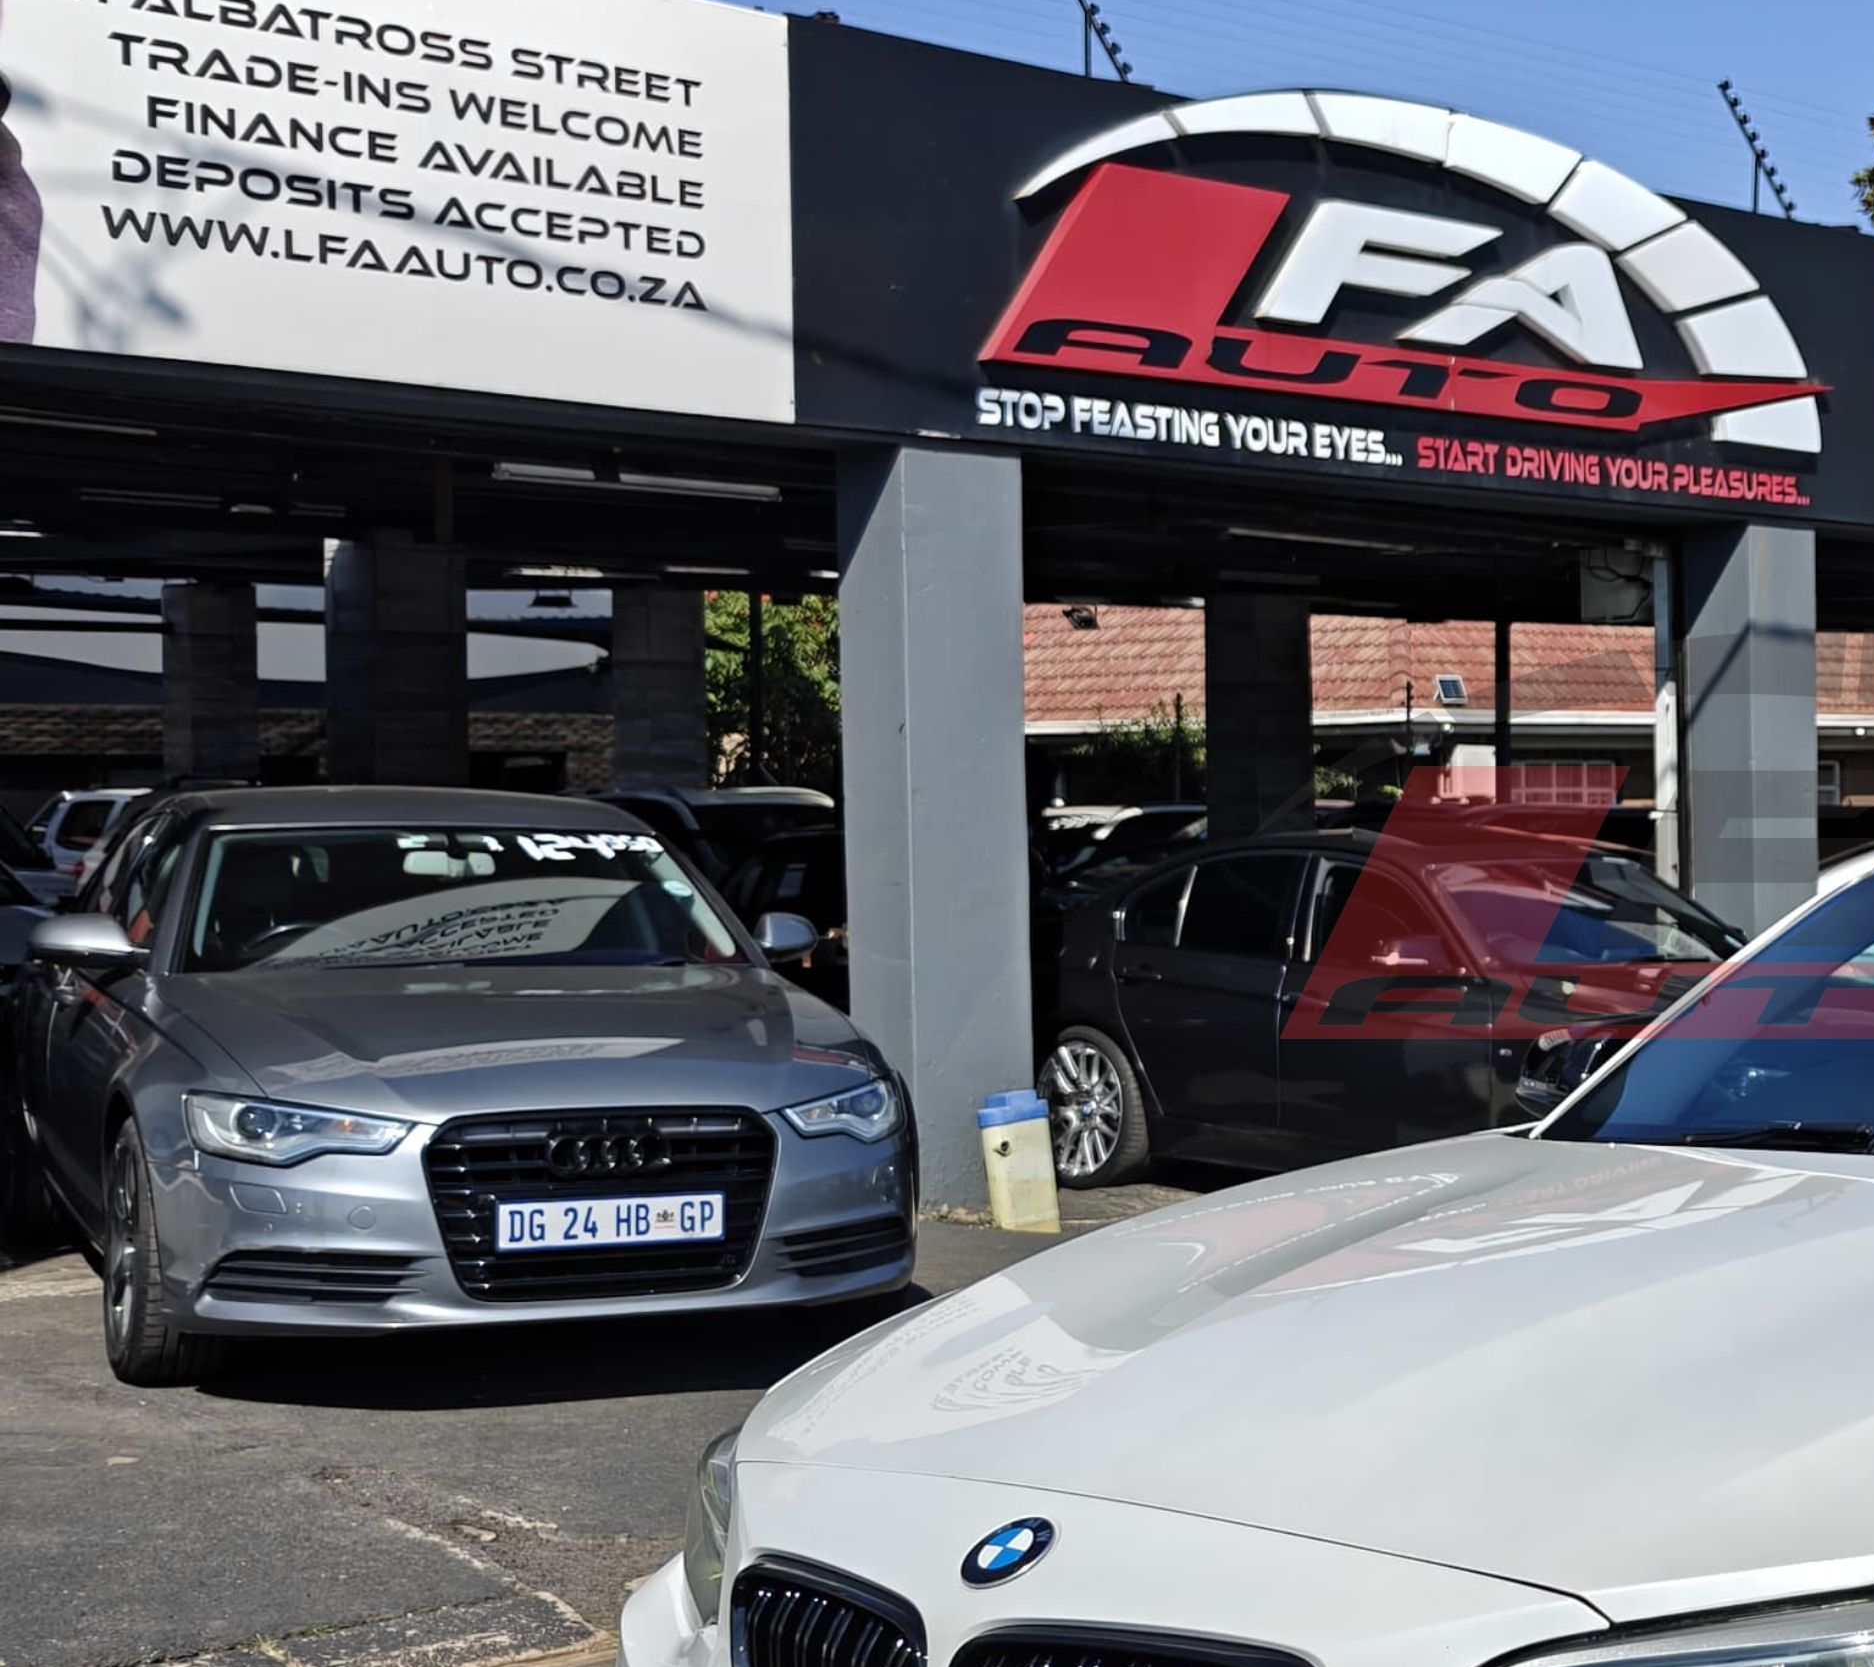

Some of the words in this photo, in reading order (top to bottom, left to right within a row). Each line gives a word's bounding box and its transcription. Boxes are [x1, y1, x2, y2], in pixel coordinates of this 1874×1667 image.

[107, 31, 431, 114] TRADE-INS
[449, 88, 703, 159] WELCOME
[511, 48, 703, 107] STREET
[147, 95, 399, 164] FINANCE
[418, 140, 705, 209] AVAILABLE
[112, 149, 416, 221] DEPOSITS
[434, 196, 705, 260] ACCEPTED
[100, 204, 708, 312] WWW.LFAAUTO.CO.ZA
[1012, 318, 1645, 422] AUTO
[976, 387, 1065, 430] STOP
[1069, 396, 1220, 447] FEASTING
[1224, 412, 1308, 457] YOUR
[1311, 423, 1403, 467] EYES...
[1416, 435, 1500, 476] START
[1505, 445, 1601, 485] DRIVING
[1604, 456, 1668, 492] YOUR
[508, 1209, 546, 1243] DG
[563, 1206, 598, 1240] 24
[616, 1203, 650, 1238] HB
[680, 1200, 714, 1233] GP
